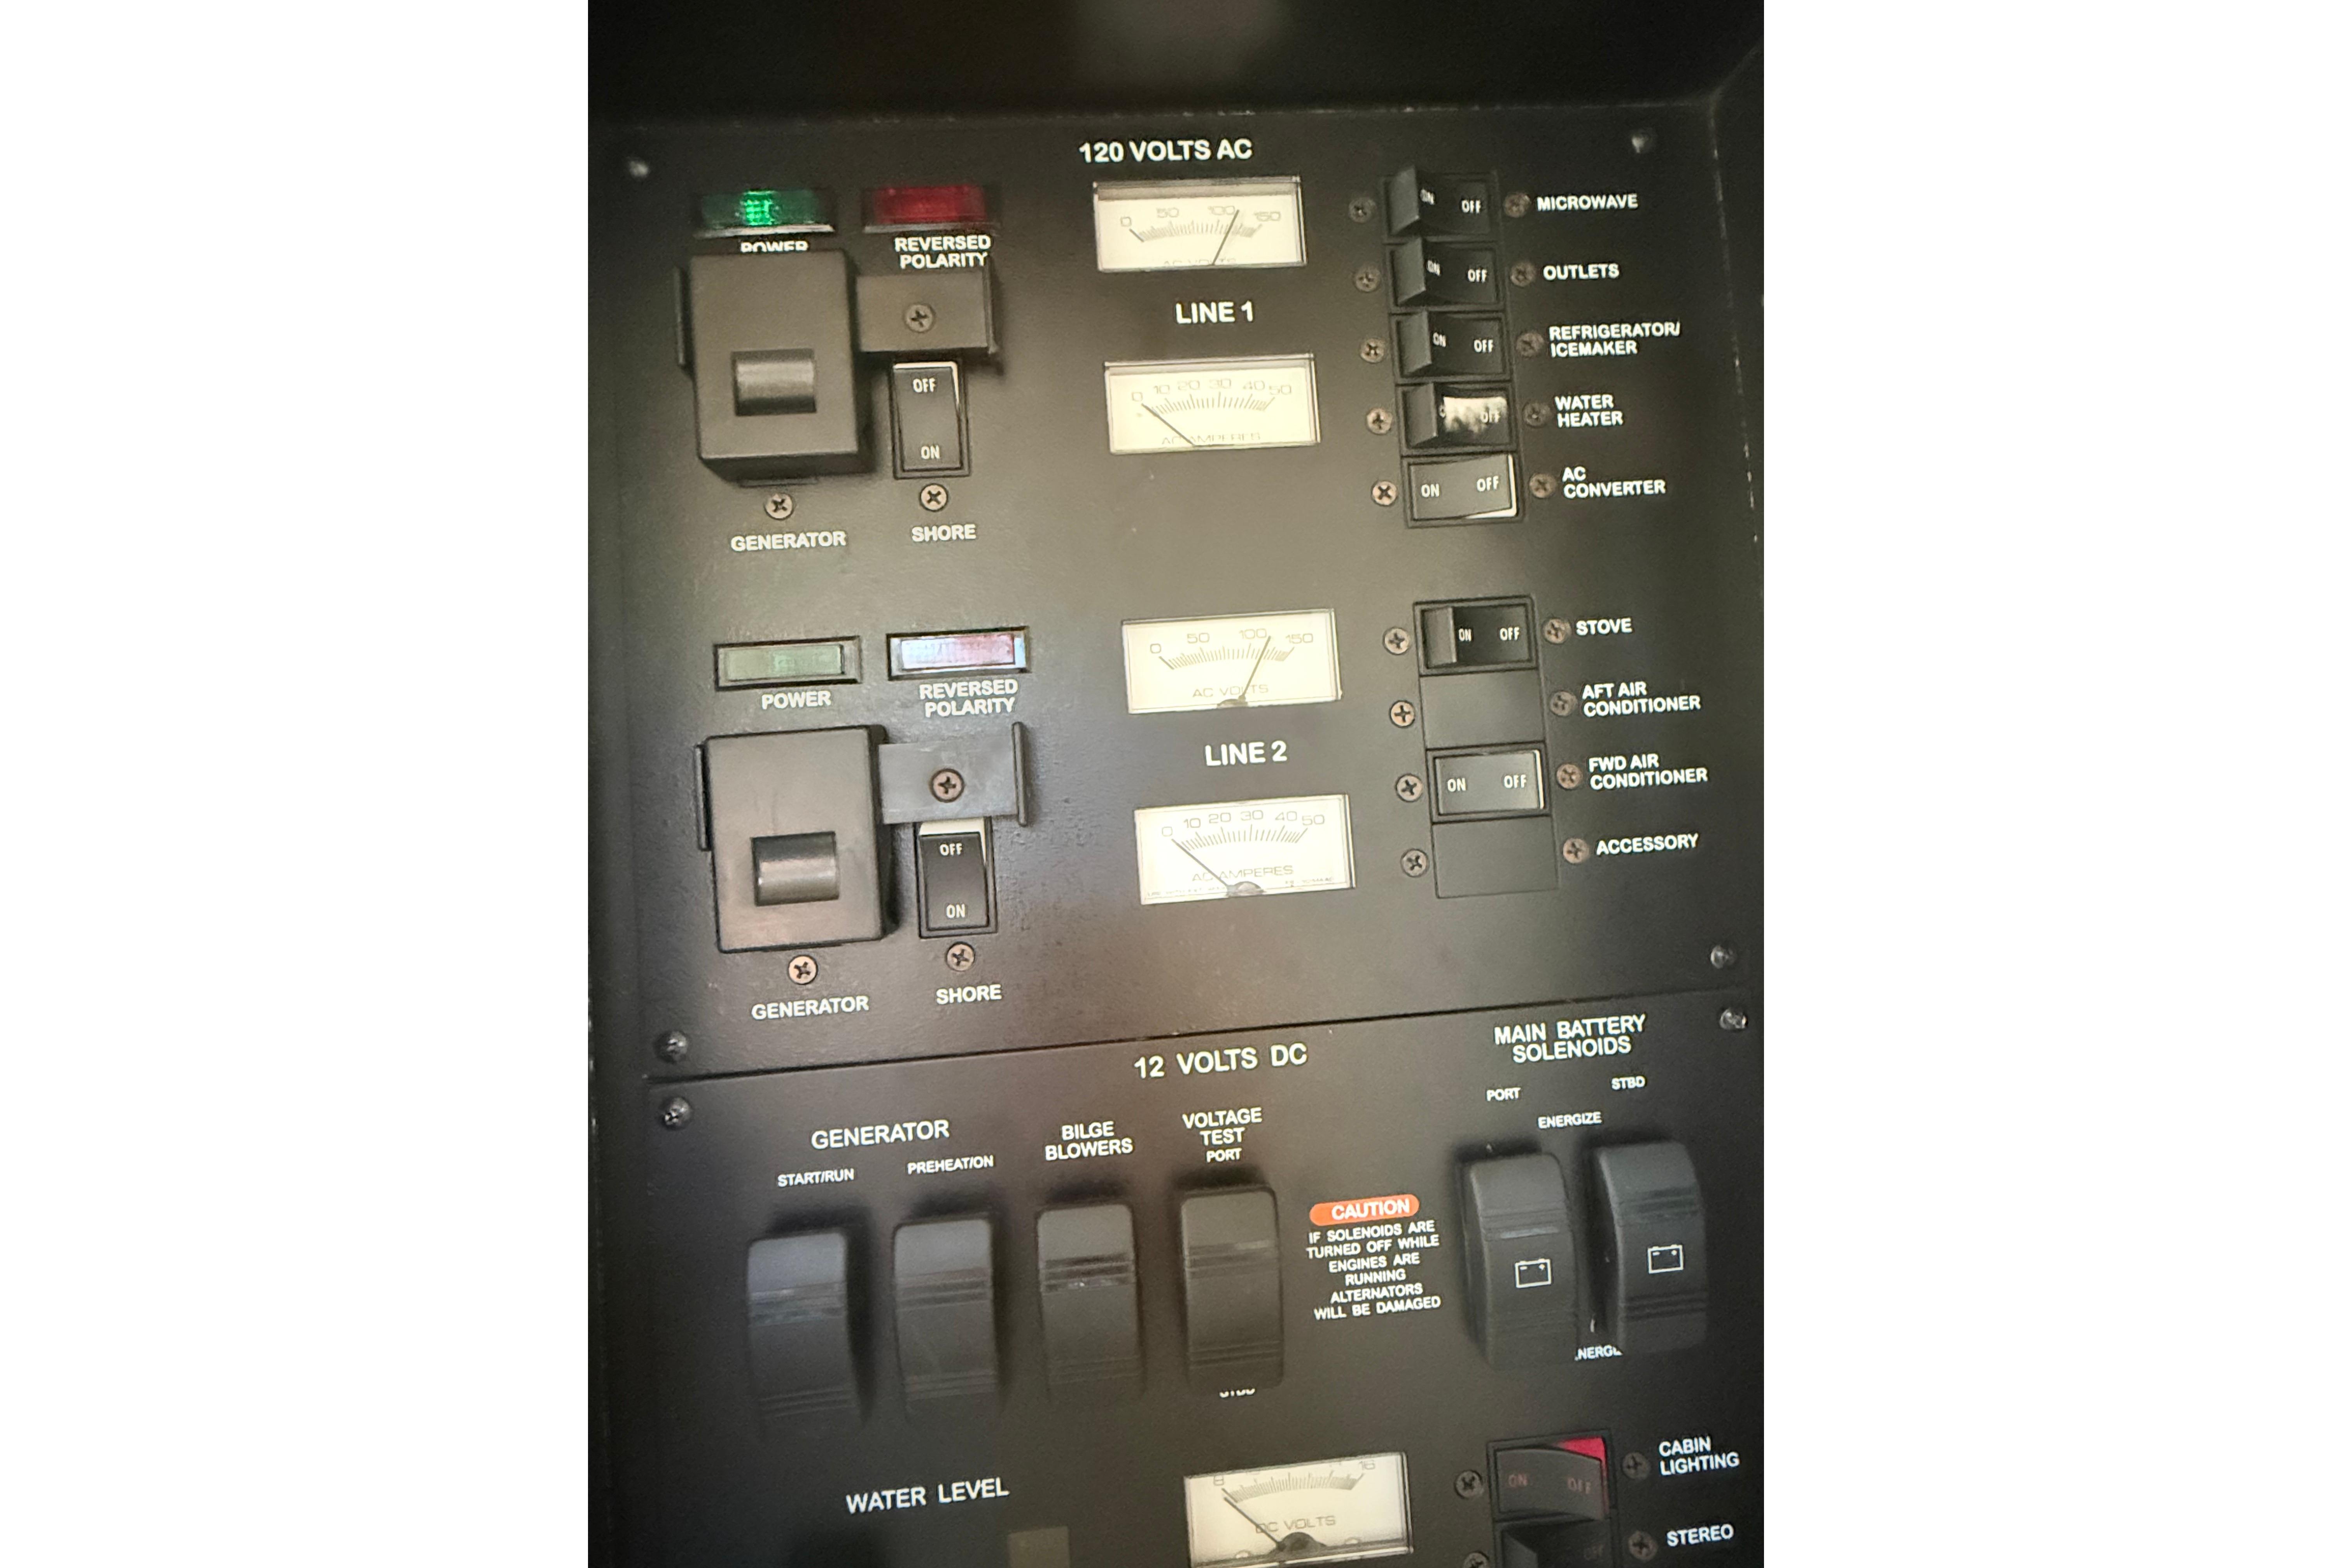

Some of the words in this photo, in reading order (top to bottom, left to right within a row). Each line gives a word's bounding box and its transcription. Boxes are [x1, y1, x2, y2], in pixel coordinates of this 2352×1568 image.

[1078, 142, 1124, 163] 120
[1129, 139, 1211, 163] VOLTS
[1217, 138, 1253, 160] AC
[1420, 189, 1435, 205] ON
[1537, 193, 1638, 212] MICROWAVE
[1461, 200, 1481, 214] OFF
[894, 235, 991, 252] REVERSED
[900, 252, 988, 270] POLARITY
[1427, 261, 1440, 276] ON
[1467, 269, 1487, 283] OFF
[1543, 263, 1620, 280] OUTLETS
[1176, 302, 1235, 324] LINE
[1241, 301, 1254, 321] 1
[1433, 332, 1446, 348] ON
[1549, 322, 1680, 341] REFRIGERATOR/
[1474, 339, 1494, 353] OFF
[1551, 340, 1638, 358] ICEMAKER
[913, 378, 936, 393] OFF
[1153, 385, 1170, 394] 10
[1178, 380, 1200, 390] 20
[1209, 378, 1232, 389] 30
[1242, 380, 1265, 390] 40
[1269, 385, 1292, 395] 50
[1131, 392, 1143, 401] 0
[1555, 395, 1614, 410] WATER
[1557, 411, 1624, 428] HEATER
[920, 446, 940, 460] ON
[1562, 467, 1586, 482] AC
[1421, 484, 1440, 497] ON
[1477, 476, 1499, 492] OFF
[1563, 480, 1666, 499] CONVERTER
[730, 530, 847, 552] GENERATOR
[911, 524, 977, 542] SHORE
[1239, 628, 1267, 639] 100
[1458, 628, 1472, 642] ON
[1500, 627, 1520, 641] OFF
[1576, 618, 1632, 635] STOVE
[1187, 632, 1210, 644] 50
[1286, 634, 1313, 644] 150
[1150, 643, 1162, 654] 0
[919, 679, 1018, 700] REVERSED
[1193, 688, 1214, 698] AC
[1220, 684, 1269, 696] VOLTS
[1582, 682, 1615, 698] AFT
[1619, 681, 1647, 696] AIR
[761, 690, 831, 709] POWER
[925, 697, 1016, 718] POLARITY
[1584, 695, 1701, 717] CONDITIONER
[1205, 742, 1265, 766] LINE
[1271, 740, 1287, 762] 2
[1589, 756, 1626, 772] FWD
[1631, 754, 1659, 769] AIR
[1447, 778, 1466, 792] ON
[1504, 774, 1527, 789] OFF
[1590, 768, 1708, 790] CONDITIONER
[1183, 818, 1201, 828] 10
[1209, 813, 1231, 824] 20
[1241, 810, 1264, 821] 30
[1275, 811, 1297, 821] 40
[1302, 815, 1325, 826] 50
[1162, 826, 1173, 836] 0
[940, 843, 962, 856] OFF
[1596, 833, 1699, 855] ACCESSORY
[1192, 872, 1214, 881] AC
[1218, 865, 1293, 879] AMPERES
[946, 904, 965, 918] ON
[936, 984, 1001, 1005] SHORE
[751, 996, 869, 1020] GENERATOR
[1494, 1022, 1546, 1045] MAIN
[1557, 1013, 1646, 1039] BATTERY
[1513, 1036, 1631, 1063] SOLENOIDS
[1134, 1056, 1165, 1079] 12
[1176, 1048, 1258, 1075] VOLTS
[1270, 1043, 1307, 1067] DC
[1611, 1076, 1646, 1090] STBD
[1486, 1087, 1521, 1101] PORT
[1182, 1107, 1263, 1129] VOLTAGE
[1538, 1111, 1602, 1129] ENERGIZE
[810, 1119, 950, 1150] GENERATOR
[1061, 1120, 1115, 1141] BILGE
[1200, 1127, 1245, 1146] TEST
[1045, 1138, 1134, 1161] BLOWERS
[1206, 1148, 1242, 1163] PORT
[907, 1155, 994, 1174] PREHEAT/ON
[777, 1168, 854, 1187] START/RUN
[1331, 1199, 1409, 1220] CAUTION
[1308, 1232, 1321, 1244] IF
[1327, 1223, 1402, 1242] SOLENOIDS
[1408, 1220, 1435, 1234] ARE
[1306, 1242, 1361, 1259] TURNED
[1366, 1240, 1392, 1253] OFF
[1398, 1234, 1440, 1250] WHILE
[1329, 1256, 1387, 1273] ENGINES
[1393, 1253, 1420, 1266] ARE
[1345, 1269, 1406, 1286] RUNNING
[1330, 1283, 1423, 1304] ALTERNATORS
[1313, 1306, 1347, 1320] WILL
[1352, 1304, 1371, 1316] BE
[1376, 1296, 1441, 1313] DAMAGED
[1658, 1436, 1711, 1457] CABIN
[1660, 1452, 1740, 1476] LIGHTING
[1508, 1475, 1527, 1487] ON
[1568, 1479, 1591, 1494] OFF
[846, 1487, 926, 1514] WATER
[938, 1477, 1010, 1504] LEVEL
[1255, 1522, 1279, 1533] DC
[1284, 1516, 1336, 1530] VOLTS
[1666, 1524, 1734, 1547] STEREO
